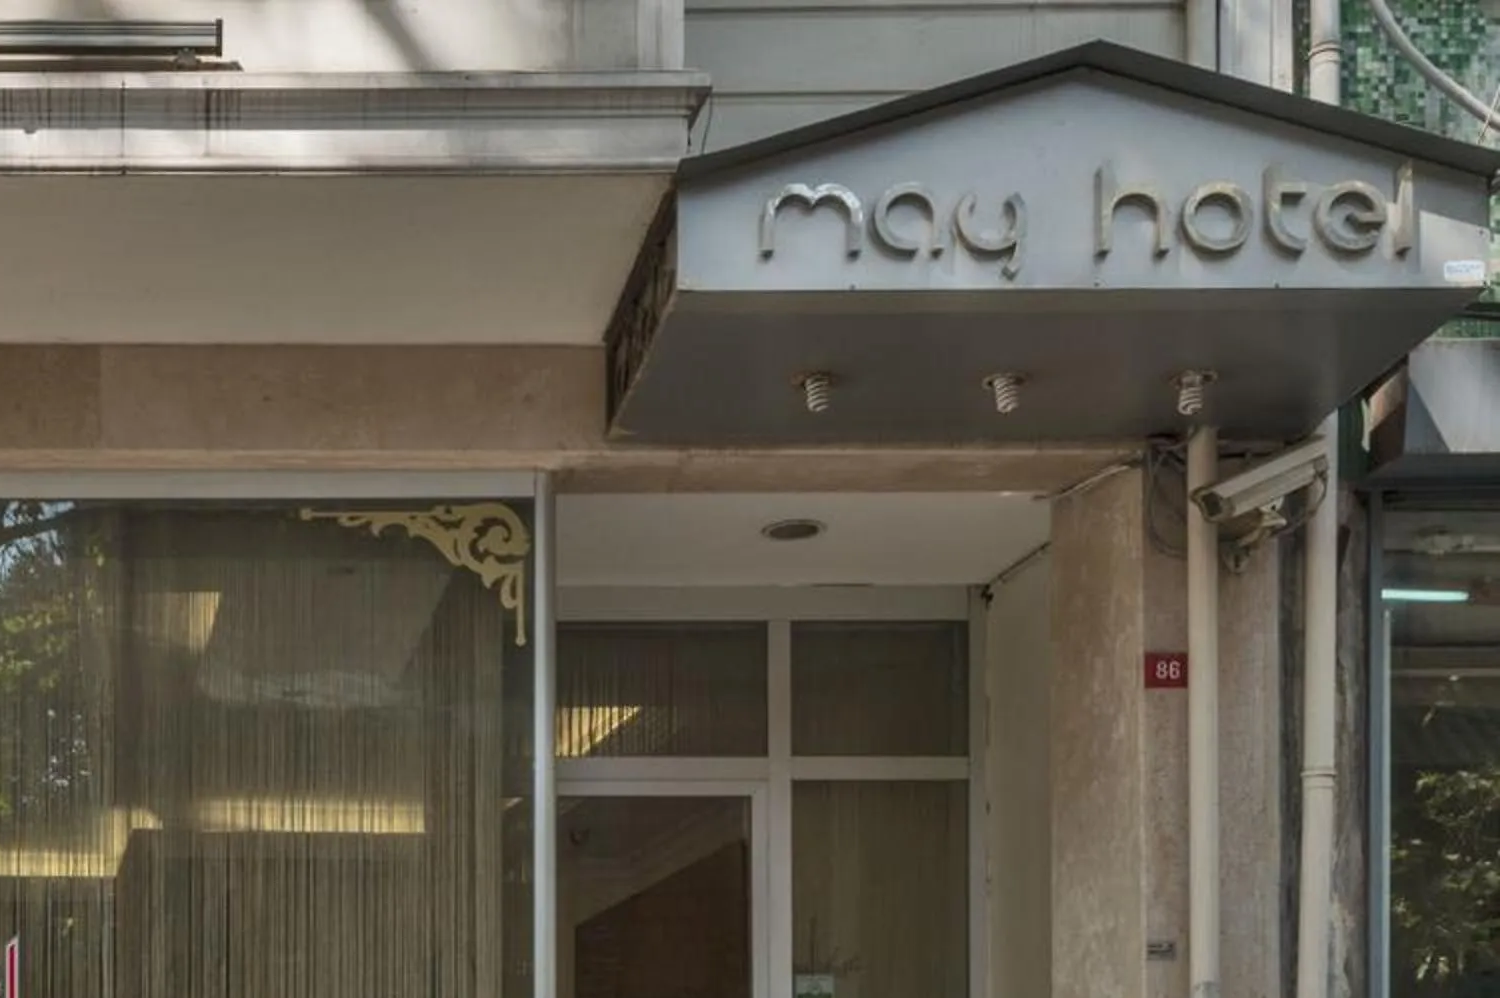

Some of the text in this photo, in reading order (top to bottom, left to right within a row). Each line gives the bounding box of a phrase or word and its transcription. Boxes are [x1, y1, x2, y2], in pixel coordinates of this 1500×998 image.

[758, 158, 1419, 281] may hotel
[1156, 660, 1181, 680] 86
